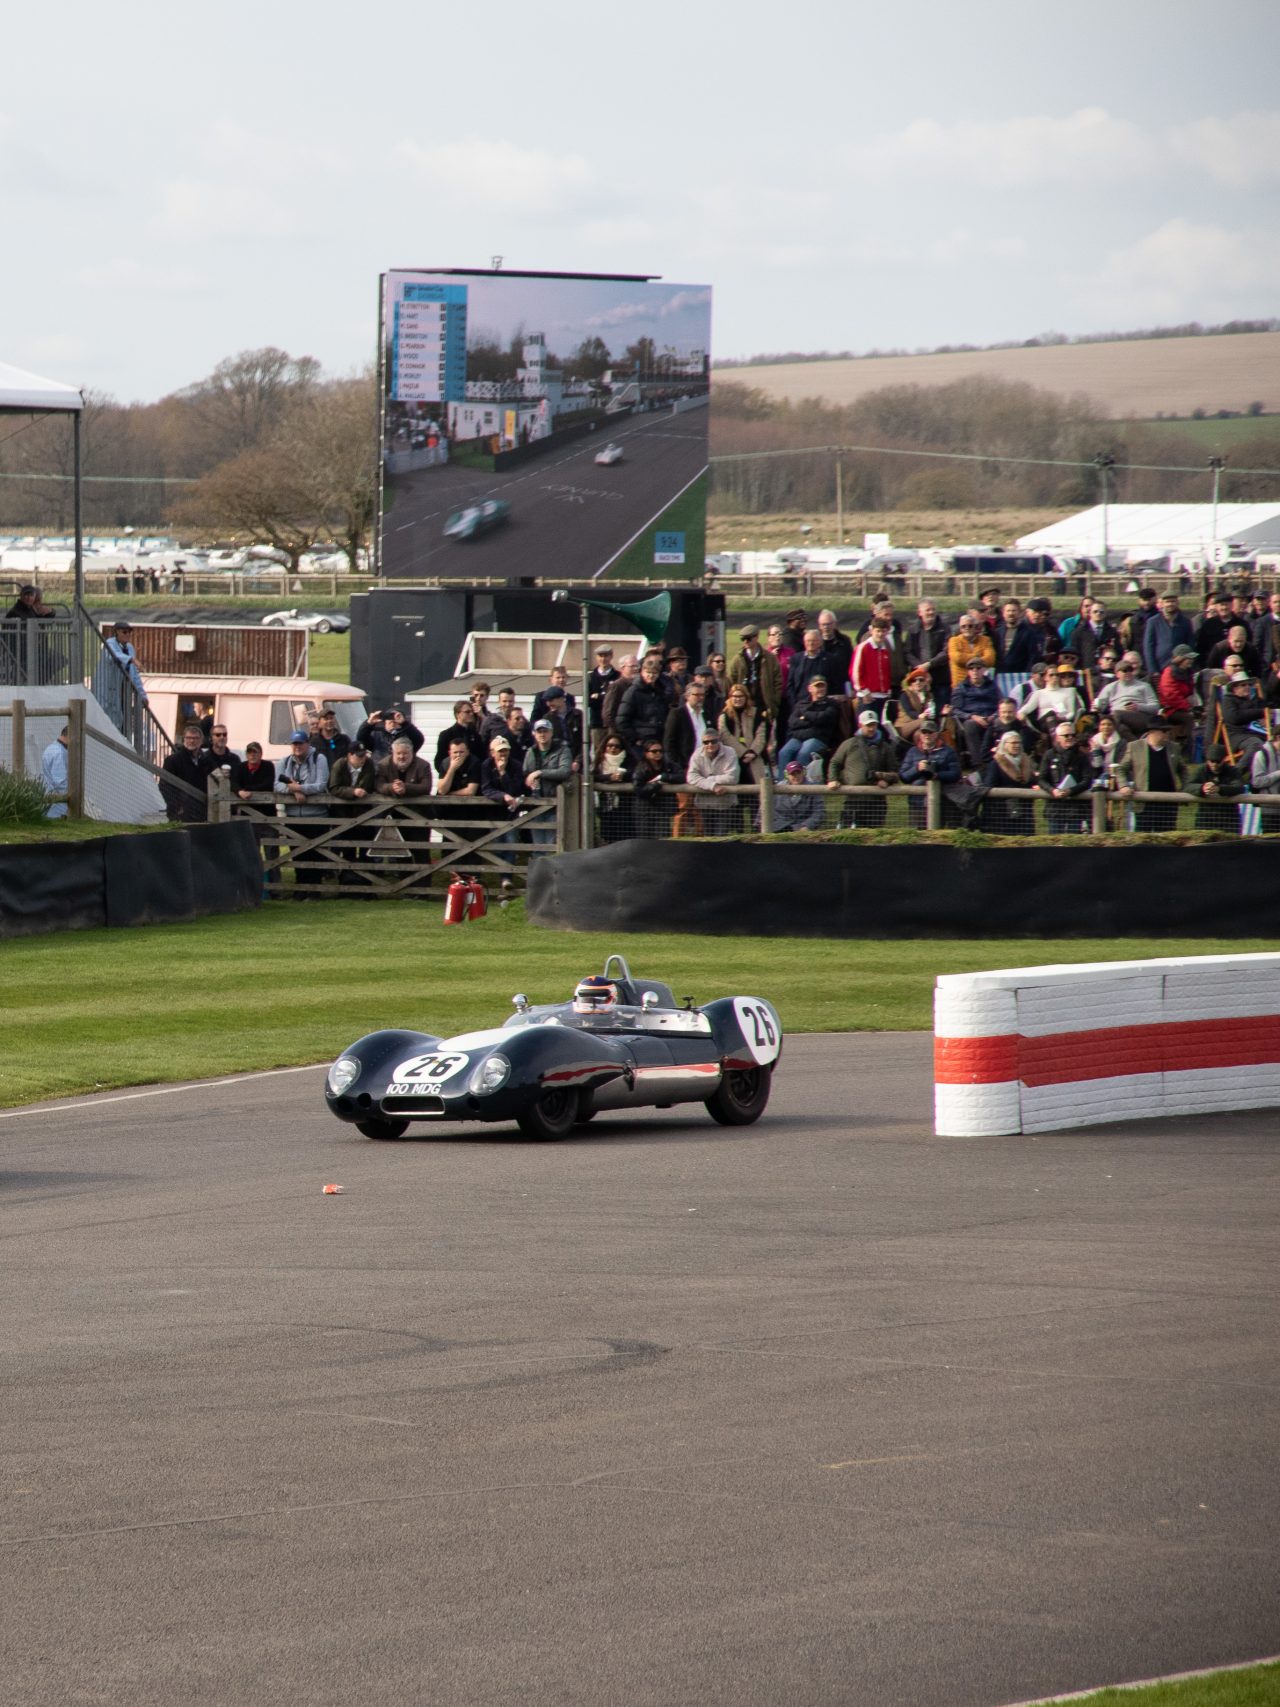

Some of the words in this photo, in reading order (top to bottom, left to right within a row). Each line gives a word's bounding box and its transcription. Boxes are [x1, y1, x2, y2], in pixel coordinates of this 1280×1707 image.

[742, 1006, 776, 1047] 26
[404, 1056, 462, 1077] 26
[386, 1083, 410, 1094] 100
[412, 1083, 442, 1094] MDG
